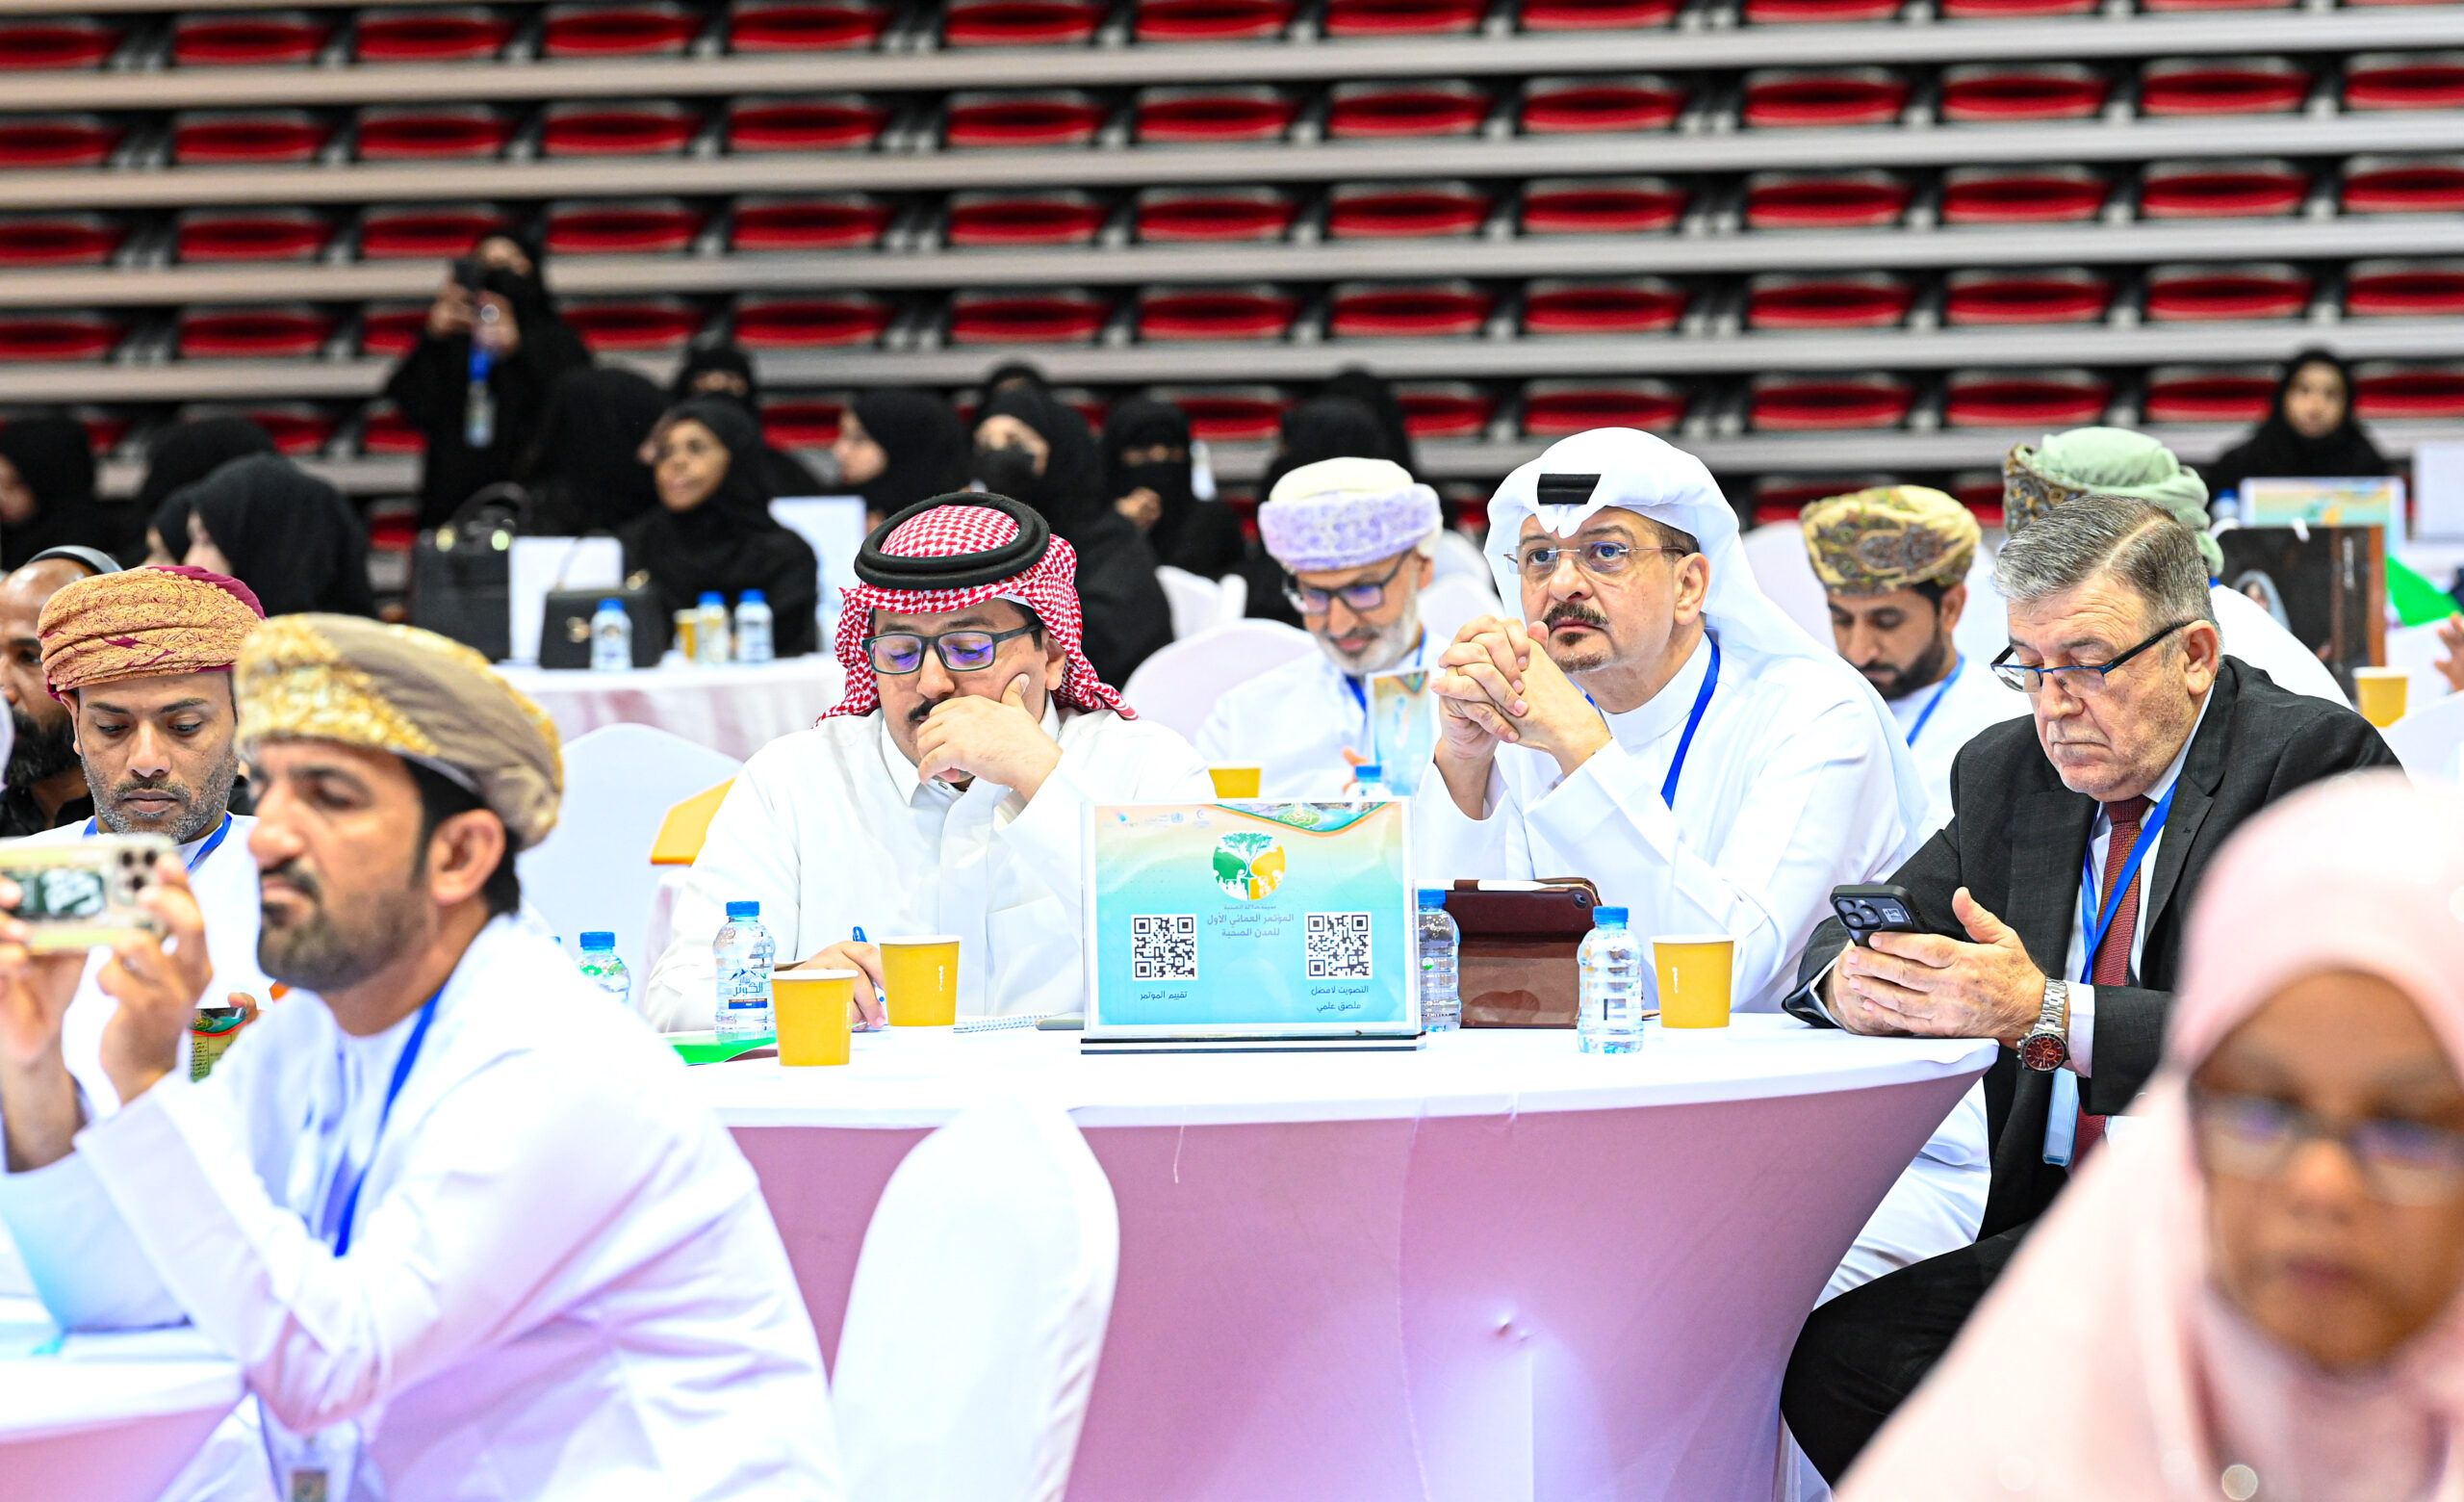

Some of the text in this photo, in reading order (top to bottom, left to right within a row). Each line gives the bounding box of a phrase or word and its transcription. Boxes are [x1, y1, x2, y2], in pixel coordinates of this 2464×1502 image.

[1207, 912, 1227, 925] الأول
[1229, 913, 1261, 927] العماني
[1221, 927, 1280, 939] للمدن الصحية
[1168, 991, 1188, 1000] تقييم
[1338, 985, 1369, 996] التصويت
[1316, 1001, 1362, 1013] ملصق علمي
